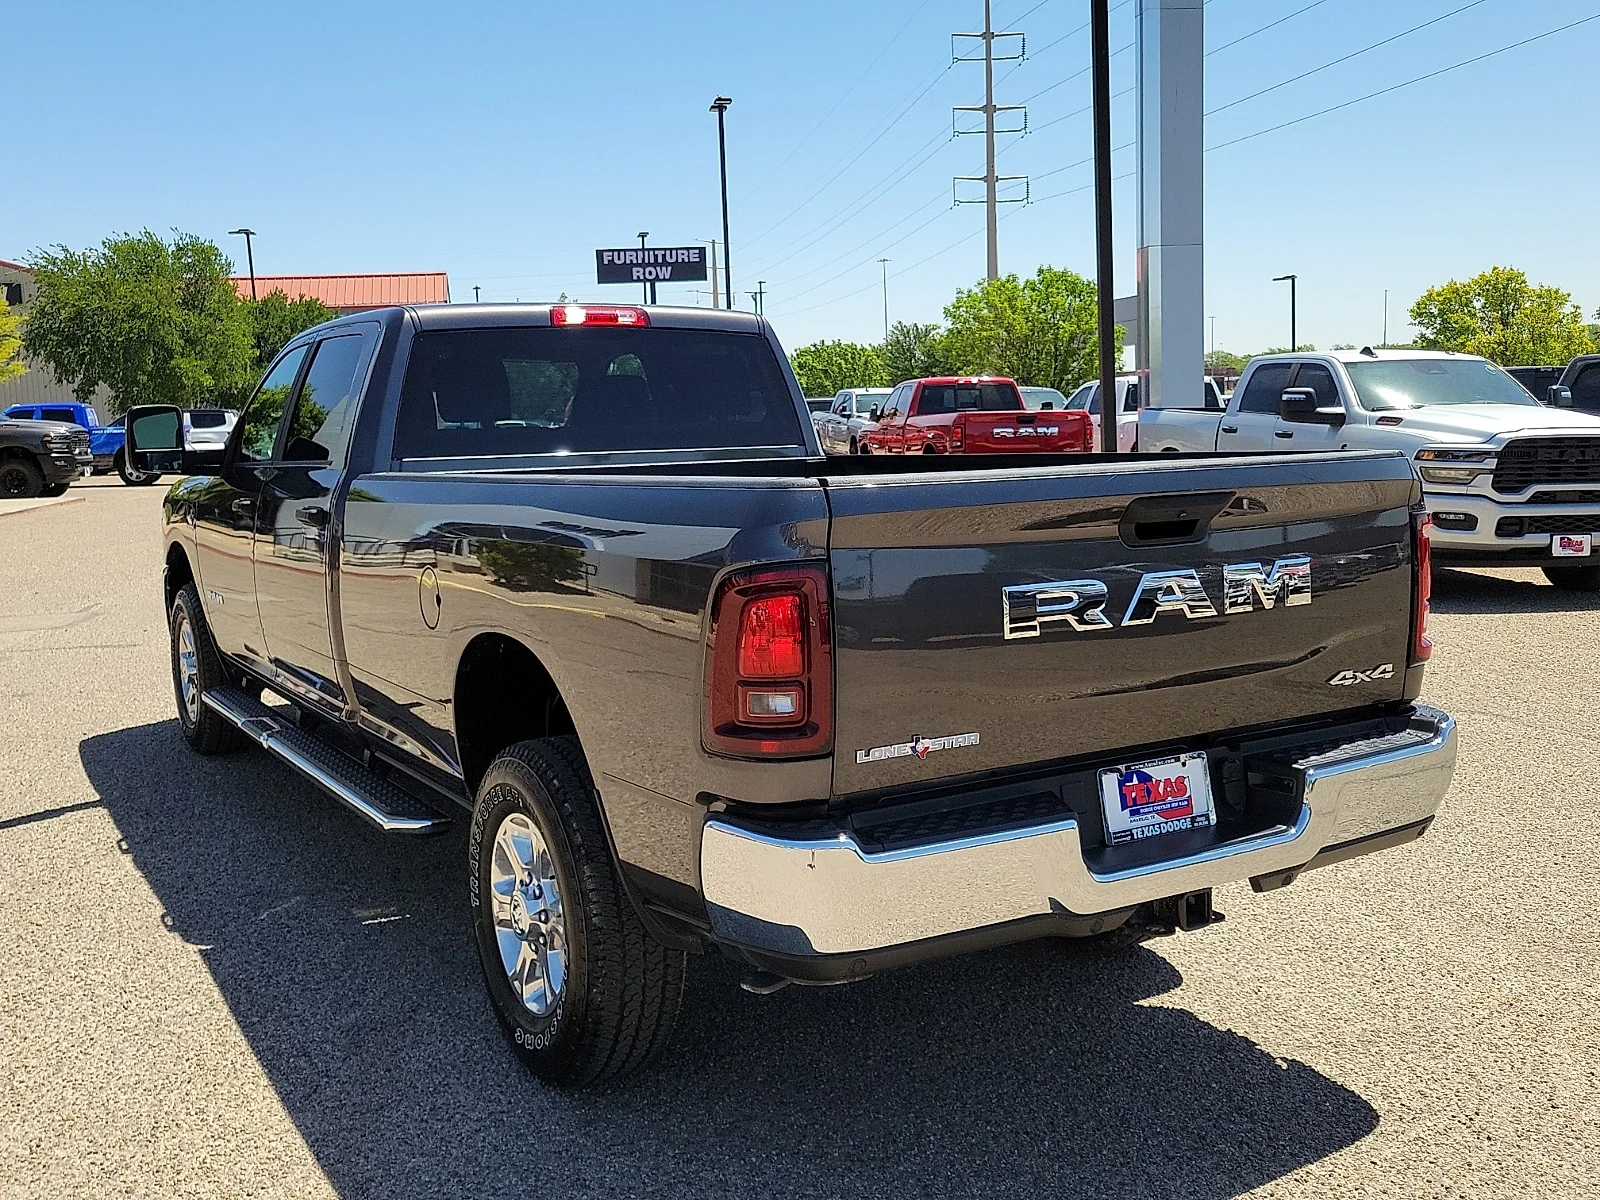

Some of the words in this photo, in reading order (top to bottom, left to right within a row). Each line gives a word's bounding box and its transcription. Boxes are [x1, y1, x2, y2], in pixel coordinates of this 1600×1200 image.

[603, 249, 700, 265] FURNITURE
[632, 266, 672, 280] ROW
[993, 426, 1059, 438] RAM
[1002, 557, 1312, 640] RAM
[1328, 663, 1395, 686] 4x4
[856, 742, 910, 763] LONE
[929, 733, 980, 751] STAR
[1122, 775, 1188, 806] TEXAS
[1132, 824, 1161, 840] TEXAS
[1160, 818, 1193, 834] DODGE
[469, 786, 504, 908] TRANSFORCE
